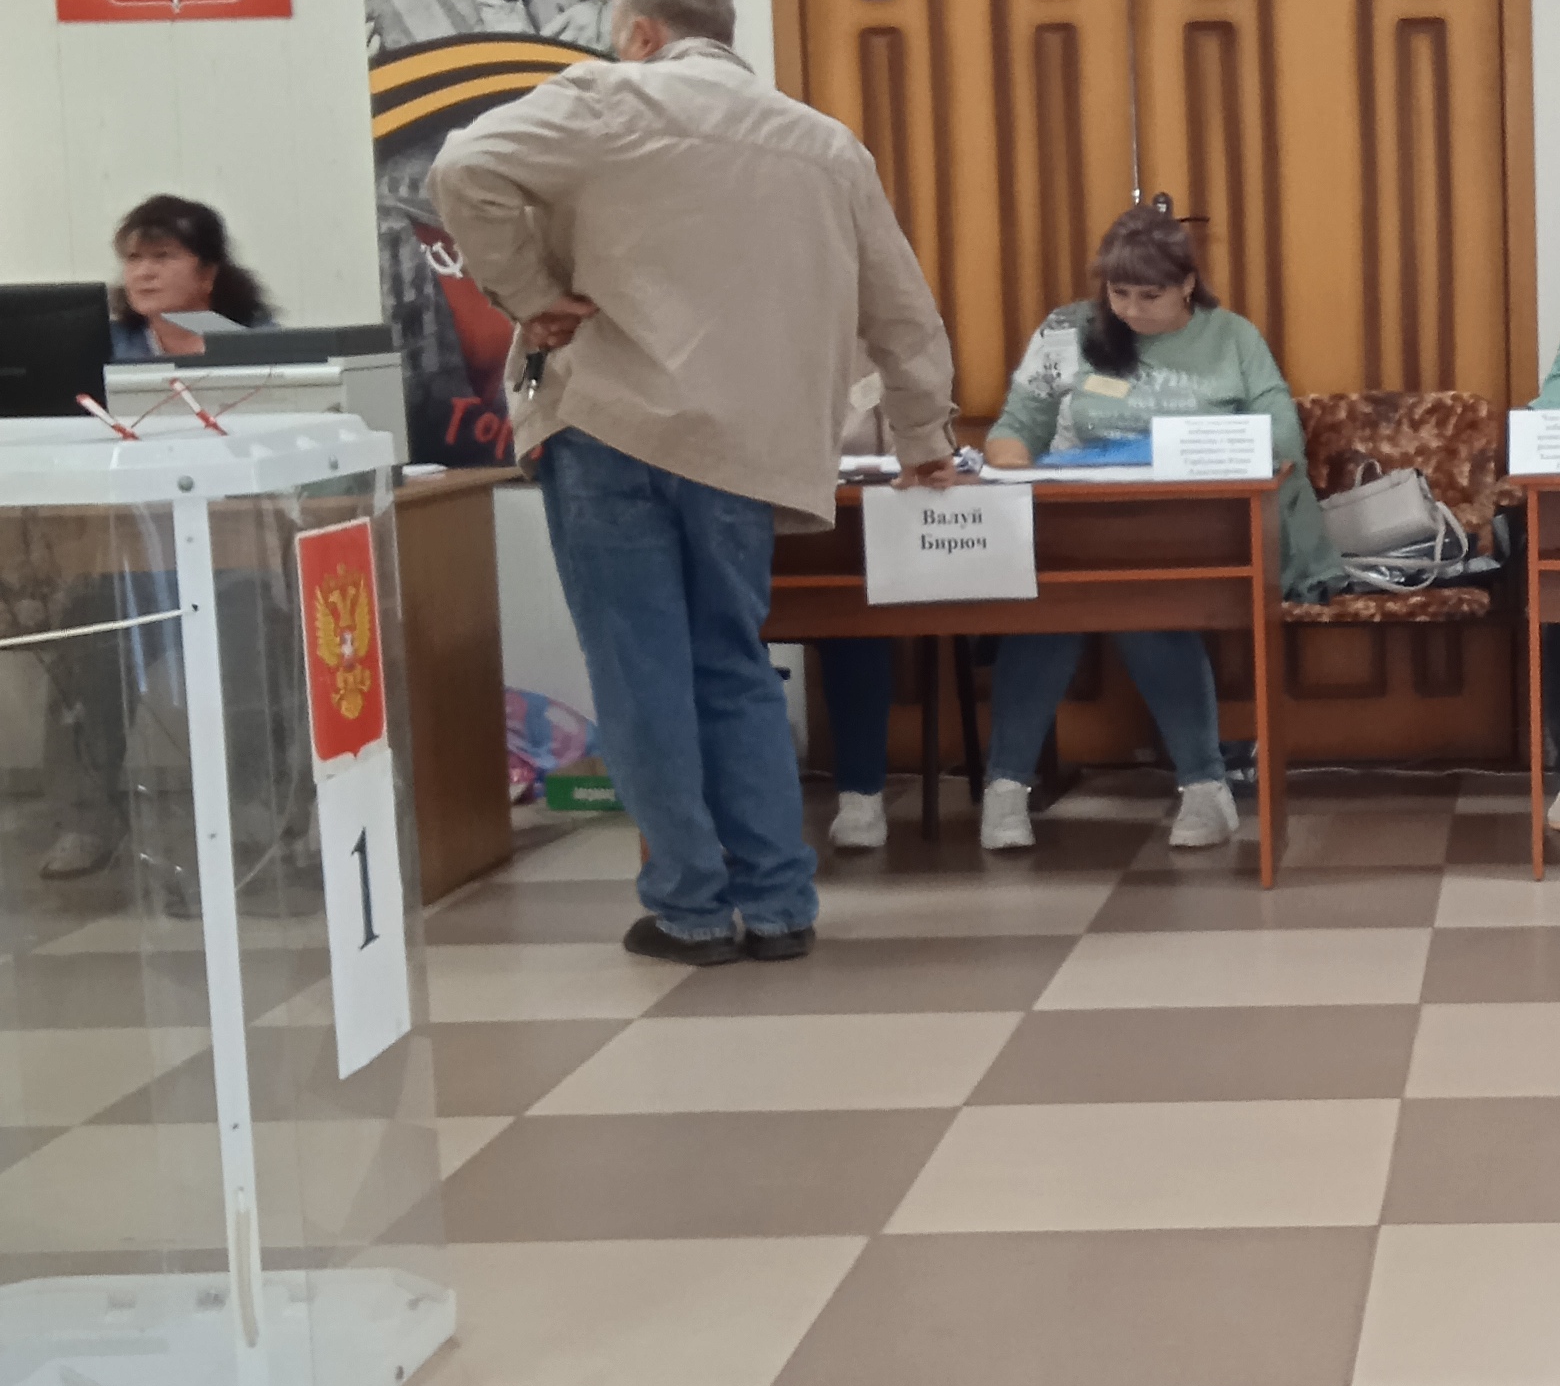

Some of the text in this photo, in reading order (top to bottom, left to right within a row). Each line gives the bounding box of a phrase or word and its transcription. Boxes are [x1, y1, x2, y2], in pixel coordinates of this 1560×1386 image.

[923, 507, 983, 529] Валуй
[921, 533, 987, 554] Бирюч
[350, 826, 380, 950] 1
